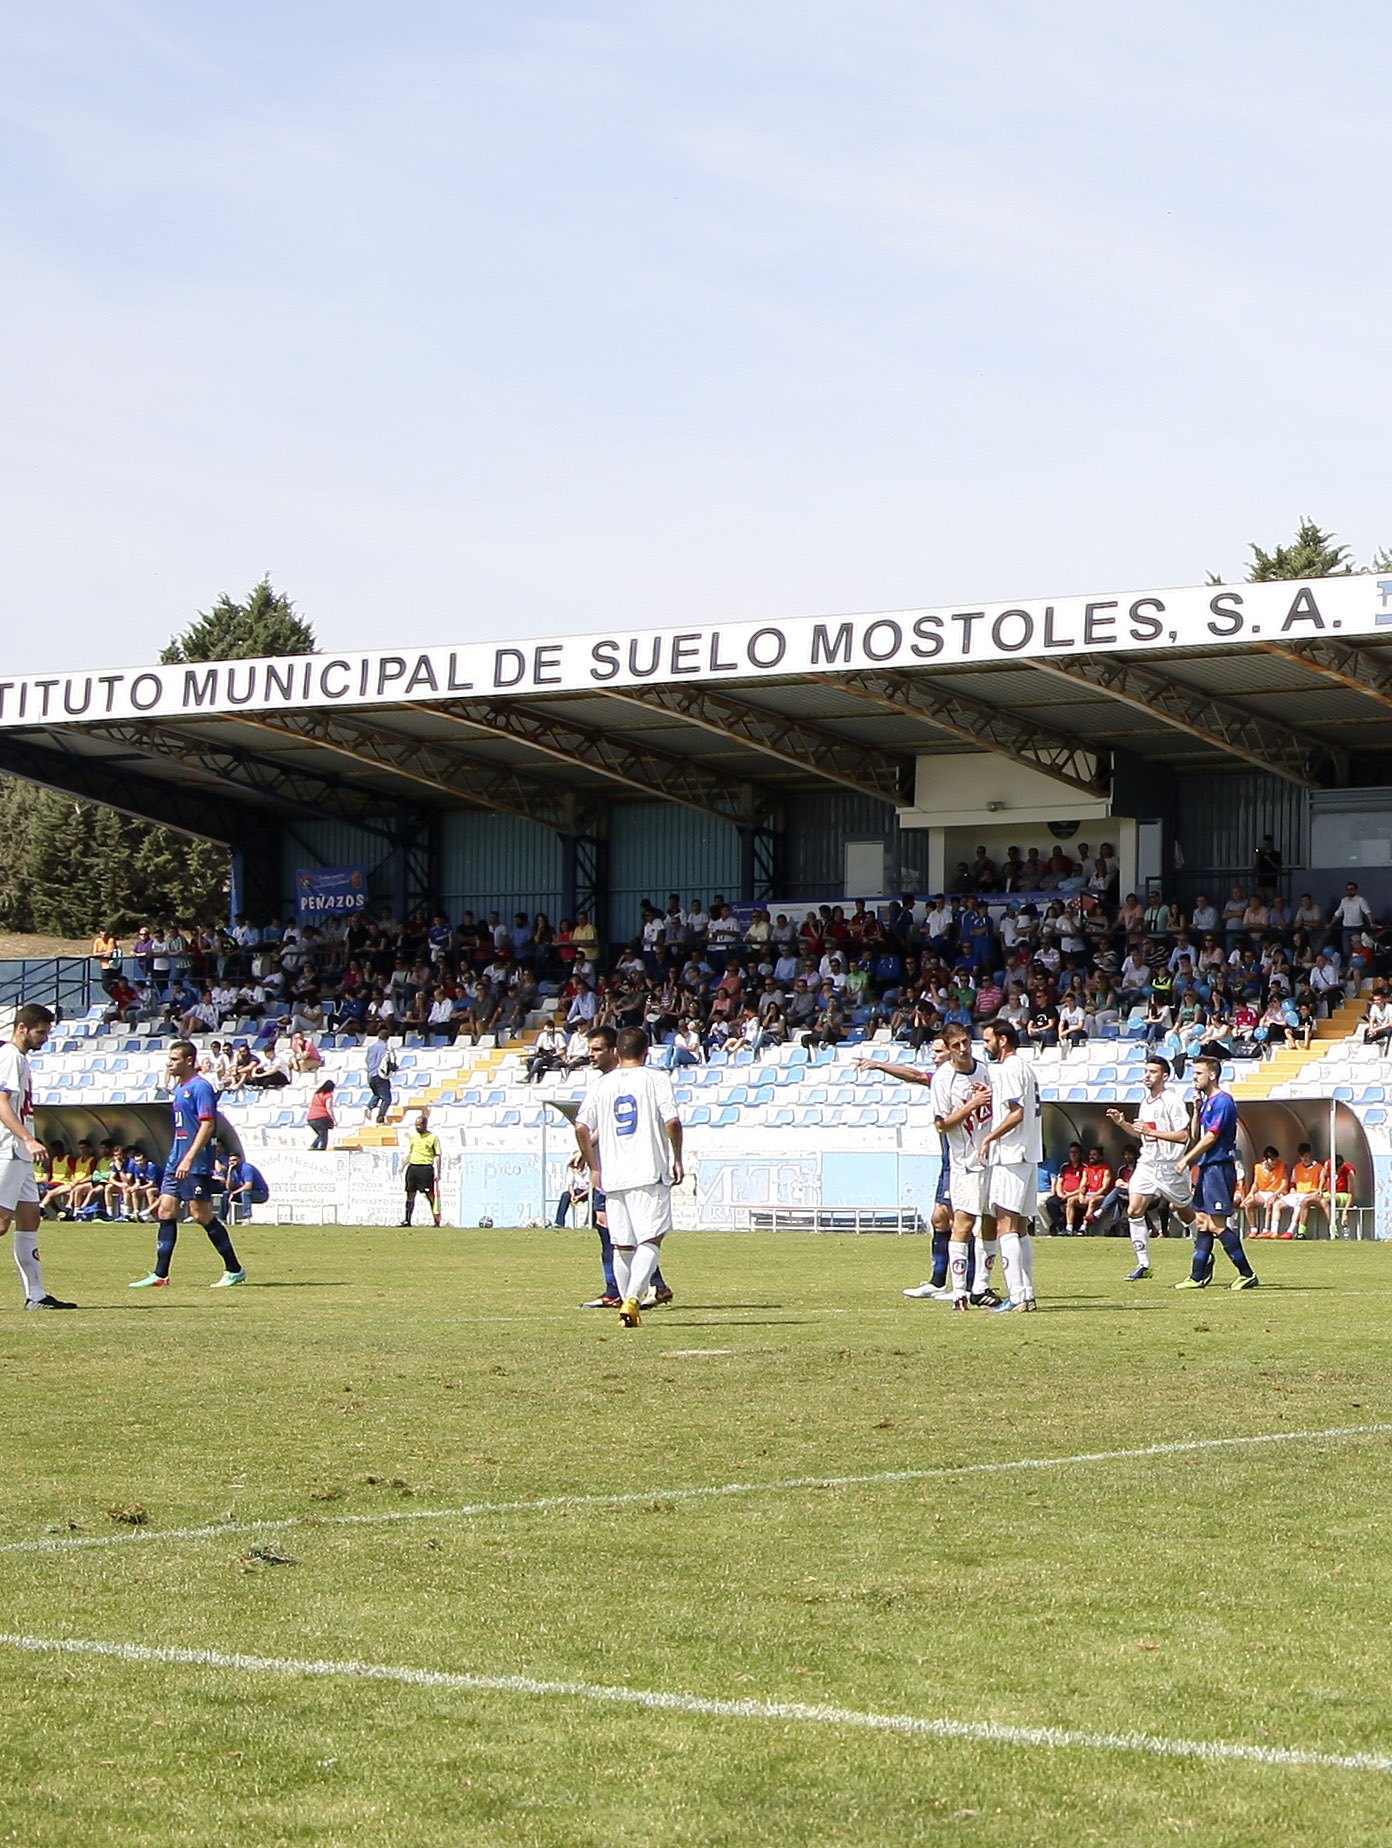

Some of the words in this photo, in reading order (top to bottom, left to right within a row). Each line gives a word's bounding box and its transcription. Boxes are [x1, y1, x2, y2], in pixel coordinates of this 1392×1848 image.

[182, 652, 473, 707] MUNICIPAL
[493, 644, 563, 688] DE
[589, 627, 787, 681] SUELO
[810, 597, 1178, 664] MOSTOLES,
[1207, 592, 1261, 636] S.
[1281, 587, 1342, 632] A.
[301, 893, 364, 910] PEÑAZOS
[614, 1094, 638, 1136] 9
